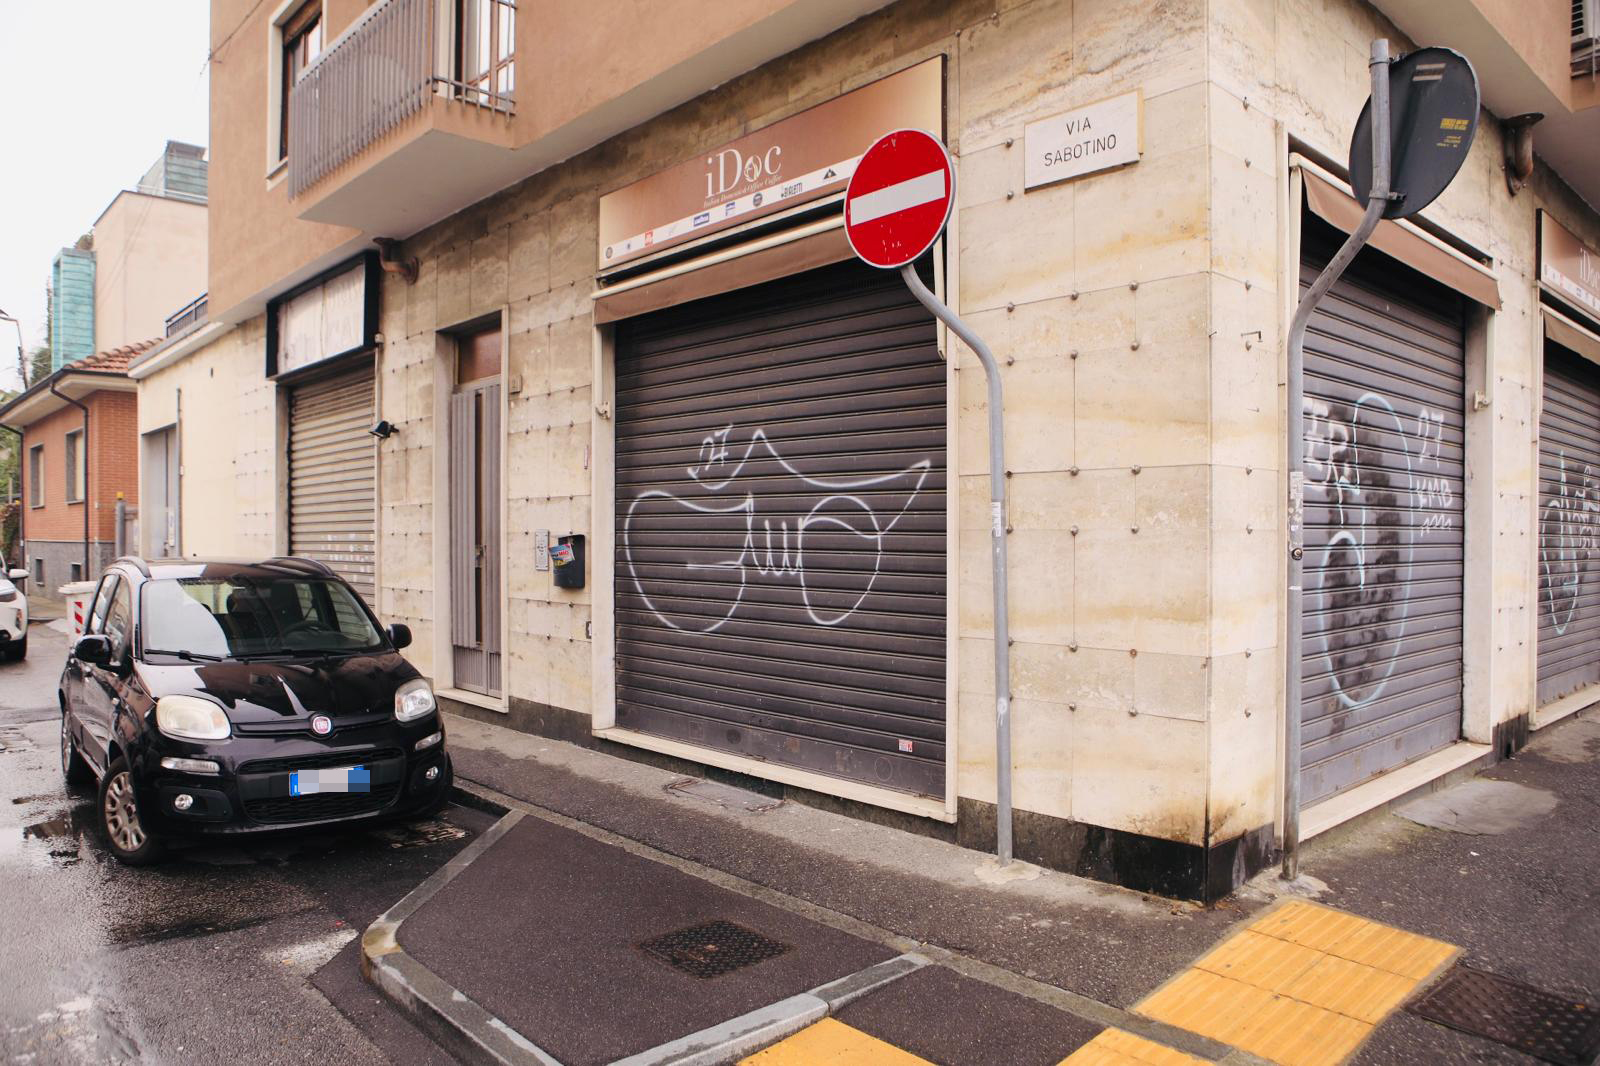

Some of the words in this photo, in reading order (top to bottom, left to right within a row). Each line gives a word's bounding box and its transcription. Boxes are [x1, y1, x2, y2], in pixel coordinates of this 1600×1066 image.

[1066, 117, 1092, 136] VIA
[1044, 134, 1117, 167] SABOTINO
[705, 145, 782, 199] iDoc
